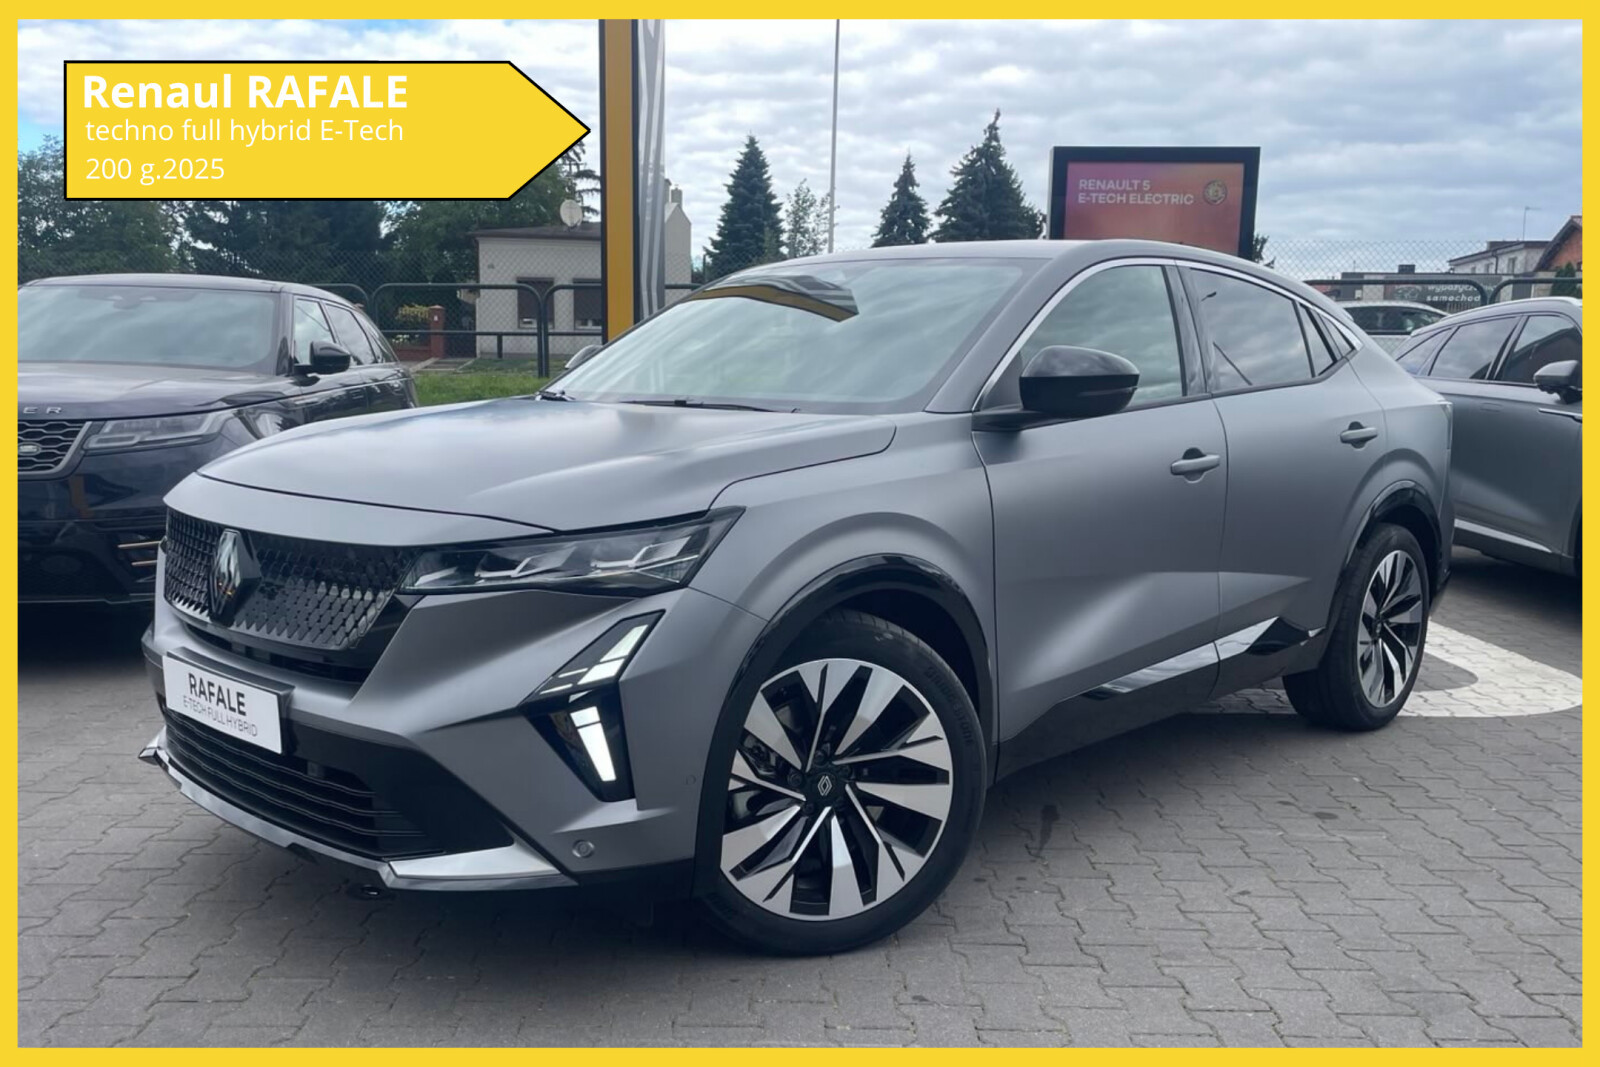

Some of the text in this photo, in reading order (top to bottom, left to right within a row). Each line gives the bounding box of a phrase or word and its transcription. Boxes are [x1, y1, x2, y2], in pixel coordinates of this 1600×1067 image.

[1078, 179, 1151, 192] RENAULT 5
[1077, 192, 1195, 206] E-TECH ELECTRIC
[1426, 293, 1481, 302] samochod
[188, 672, 247, 716] RAFALE
[183, 695, 257, 737] E-TECH FULL HYBRID
